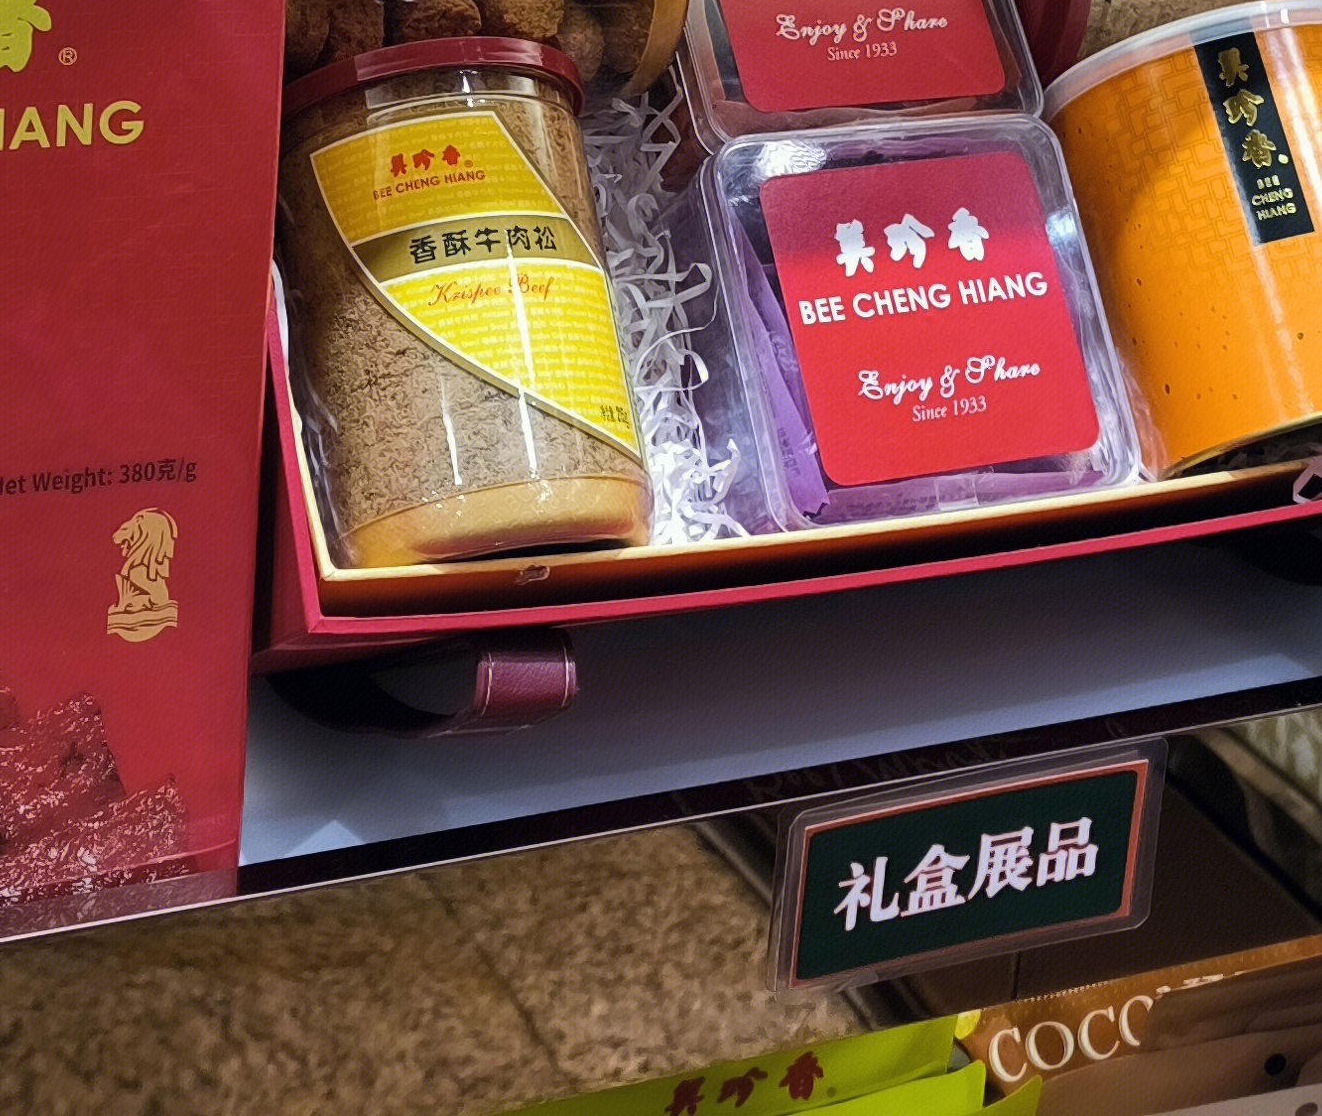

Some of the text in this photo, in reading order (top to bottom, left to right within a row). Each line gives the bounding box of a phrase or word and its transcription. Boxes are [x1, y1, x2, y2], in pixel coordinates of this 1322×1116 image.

[775, 7, 948, 46] Enjoy & Share
[827, 41, 898, 62] Since 1933
[372, 169, 486, 200] BEE CHENG HIANG
[1252, 187, 1293, 206] CHENG
[1256, 202, 1297, 221] HIANG
[409, 226, 558, 264] 香酥牛肉松
[834, 207, 989, 276] 美珍香
[508, 272, 555, 302] Beef
[798, 271, 1048, 326] BEE CHENG HIANG
[858, 355, 1041, 405] Enjoy & Share
[912, 395, 987, 422] Since 1933
[32, 467, 113, 494] Weight:
[119, 458, 197, 483] 380克/g
[834, 816, 1099, 931] 礼盒展品
